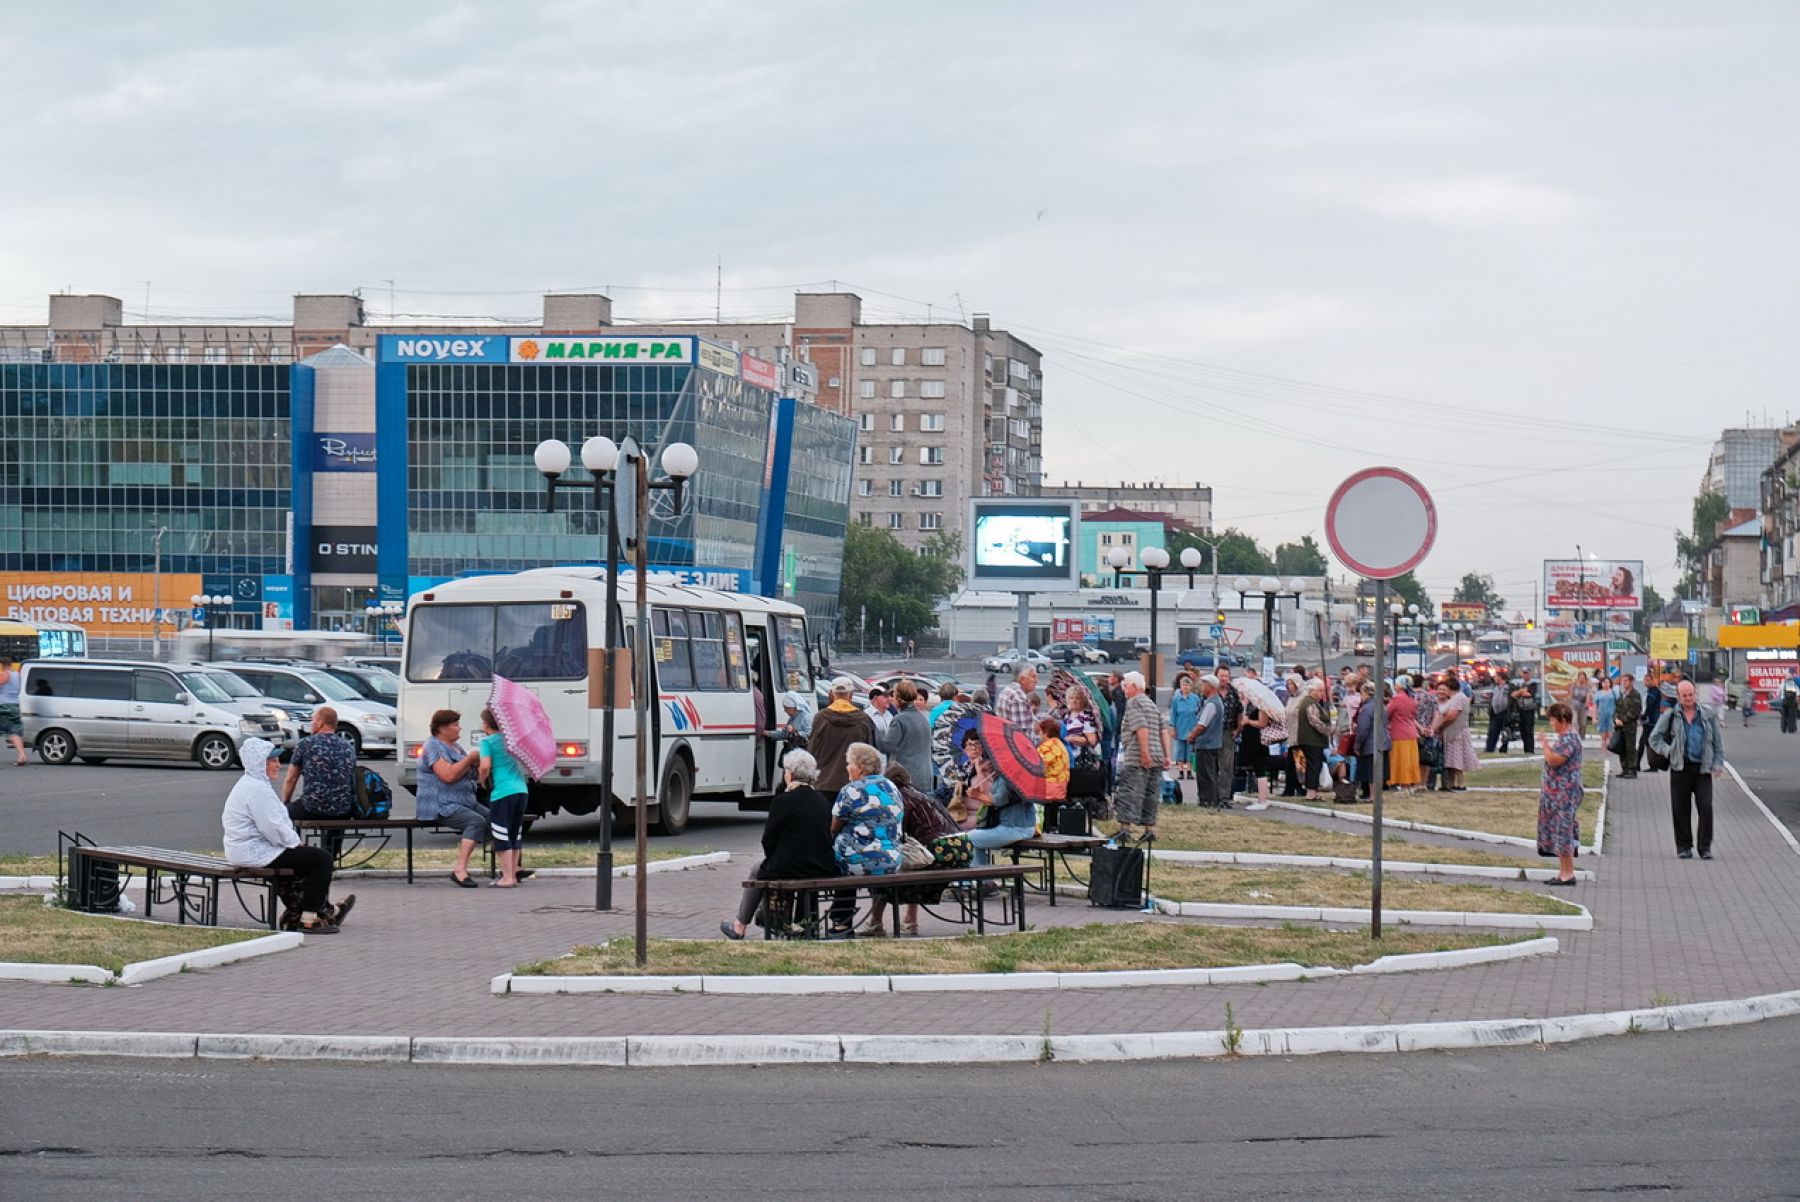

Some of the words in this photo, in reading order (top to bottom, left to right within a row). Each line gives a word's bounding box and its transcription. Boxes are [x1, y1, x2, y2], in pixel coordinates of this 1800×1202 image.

[545, 342, 683, 359] МАРИЯ-РА
[7, 585, 112, 602] ЦИФРОВАЯ
[118, 585, 133, 602] И
[8, 607, 94, 623] БЫТОВАЯ
[100, 608, 177, 625] ТЕХНИК
